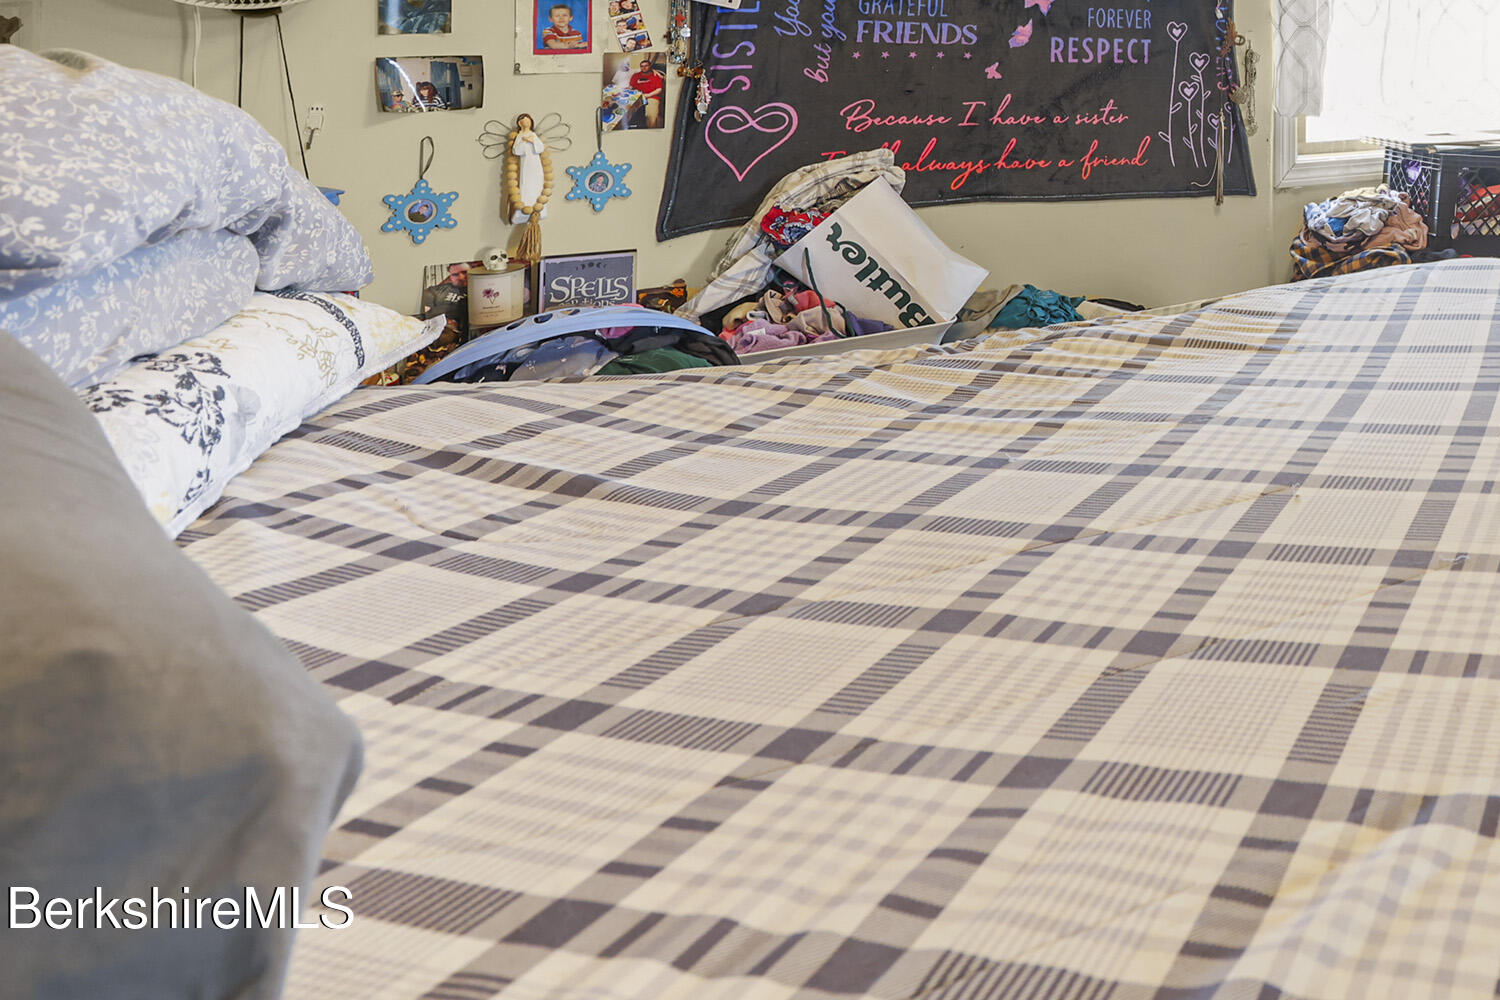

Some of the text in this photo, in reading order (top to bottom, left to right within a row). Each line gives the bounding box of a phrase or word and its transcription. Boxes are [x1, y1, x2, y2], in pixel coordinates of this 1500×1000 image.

[856, 19, 978, 45] FRIENDS
[1087, 7, 1152, 30] FOREVER
[803, 42, 832, 84] but
[1050, 36, 1152, 65] RESPECT
[840, 93, 1129, 133] Because I have a sister
[902, 136, 991, 190] always
[993, 137, 1052, 171] have
[1057, 157, 1075, 168] a
[1080, 135, 1151, 181] friend
[826, 222, 937, 328] Butler
